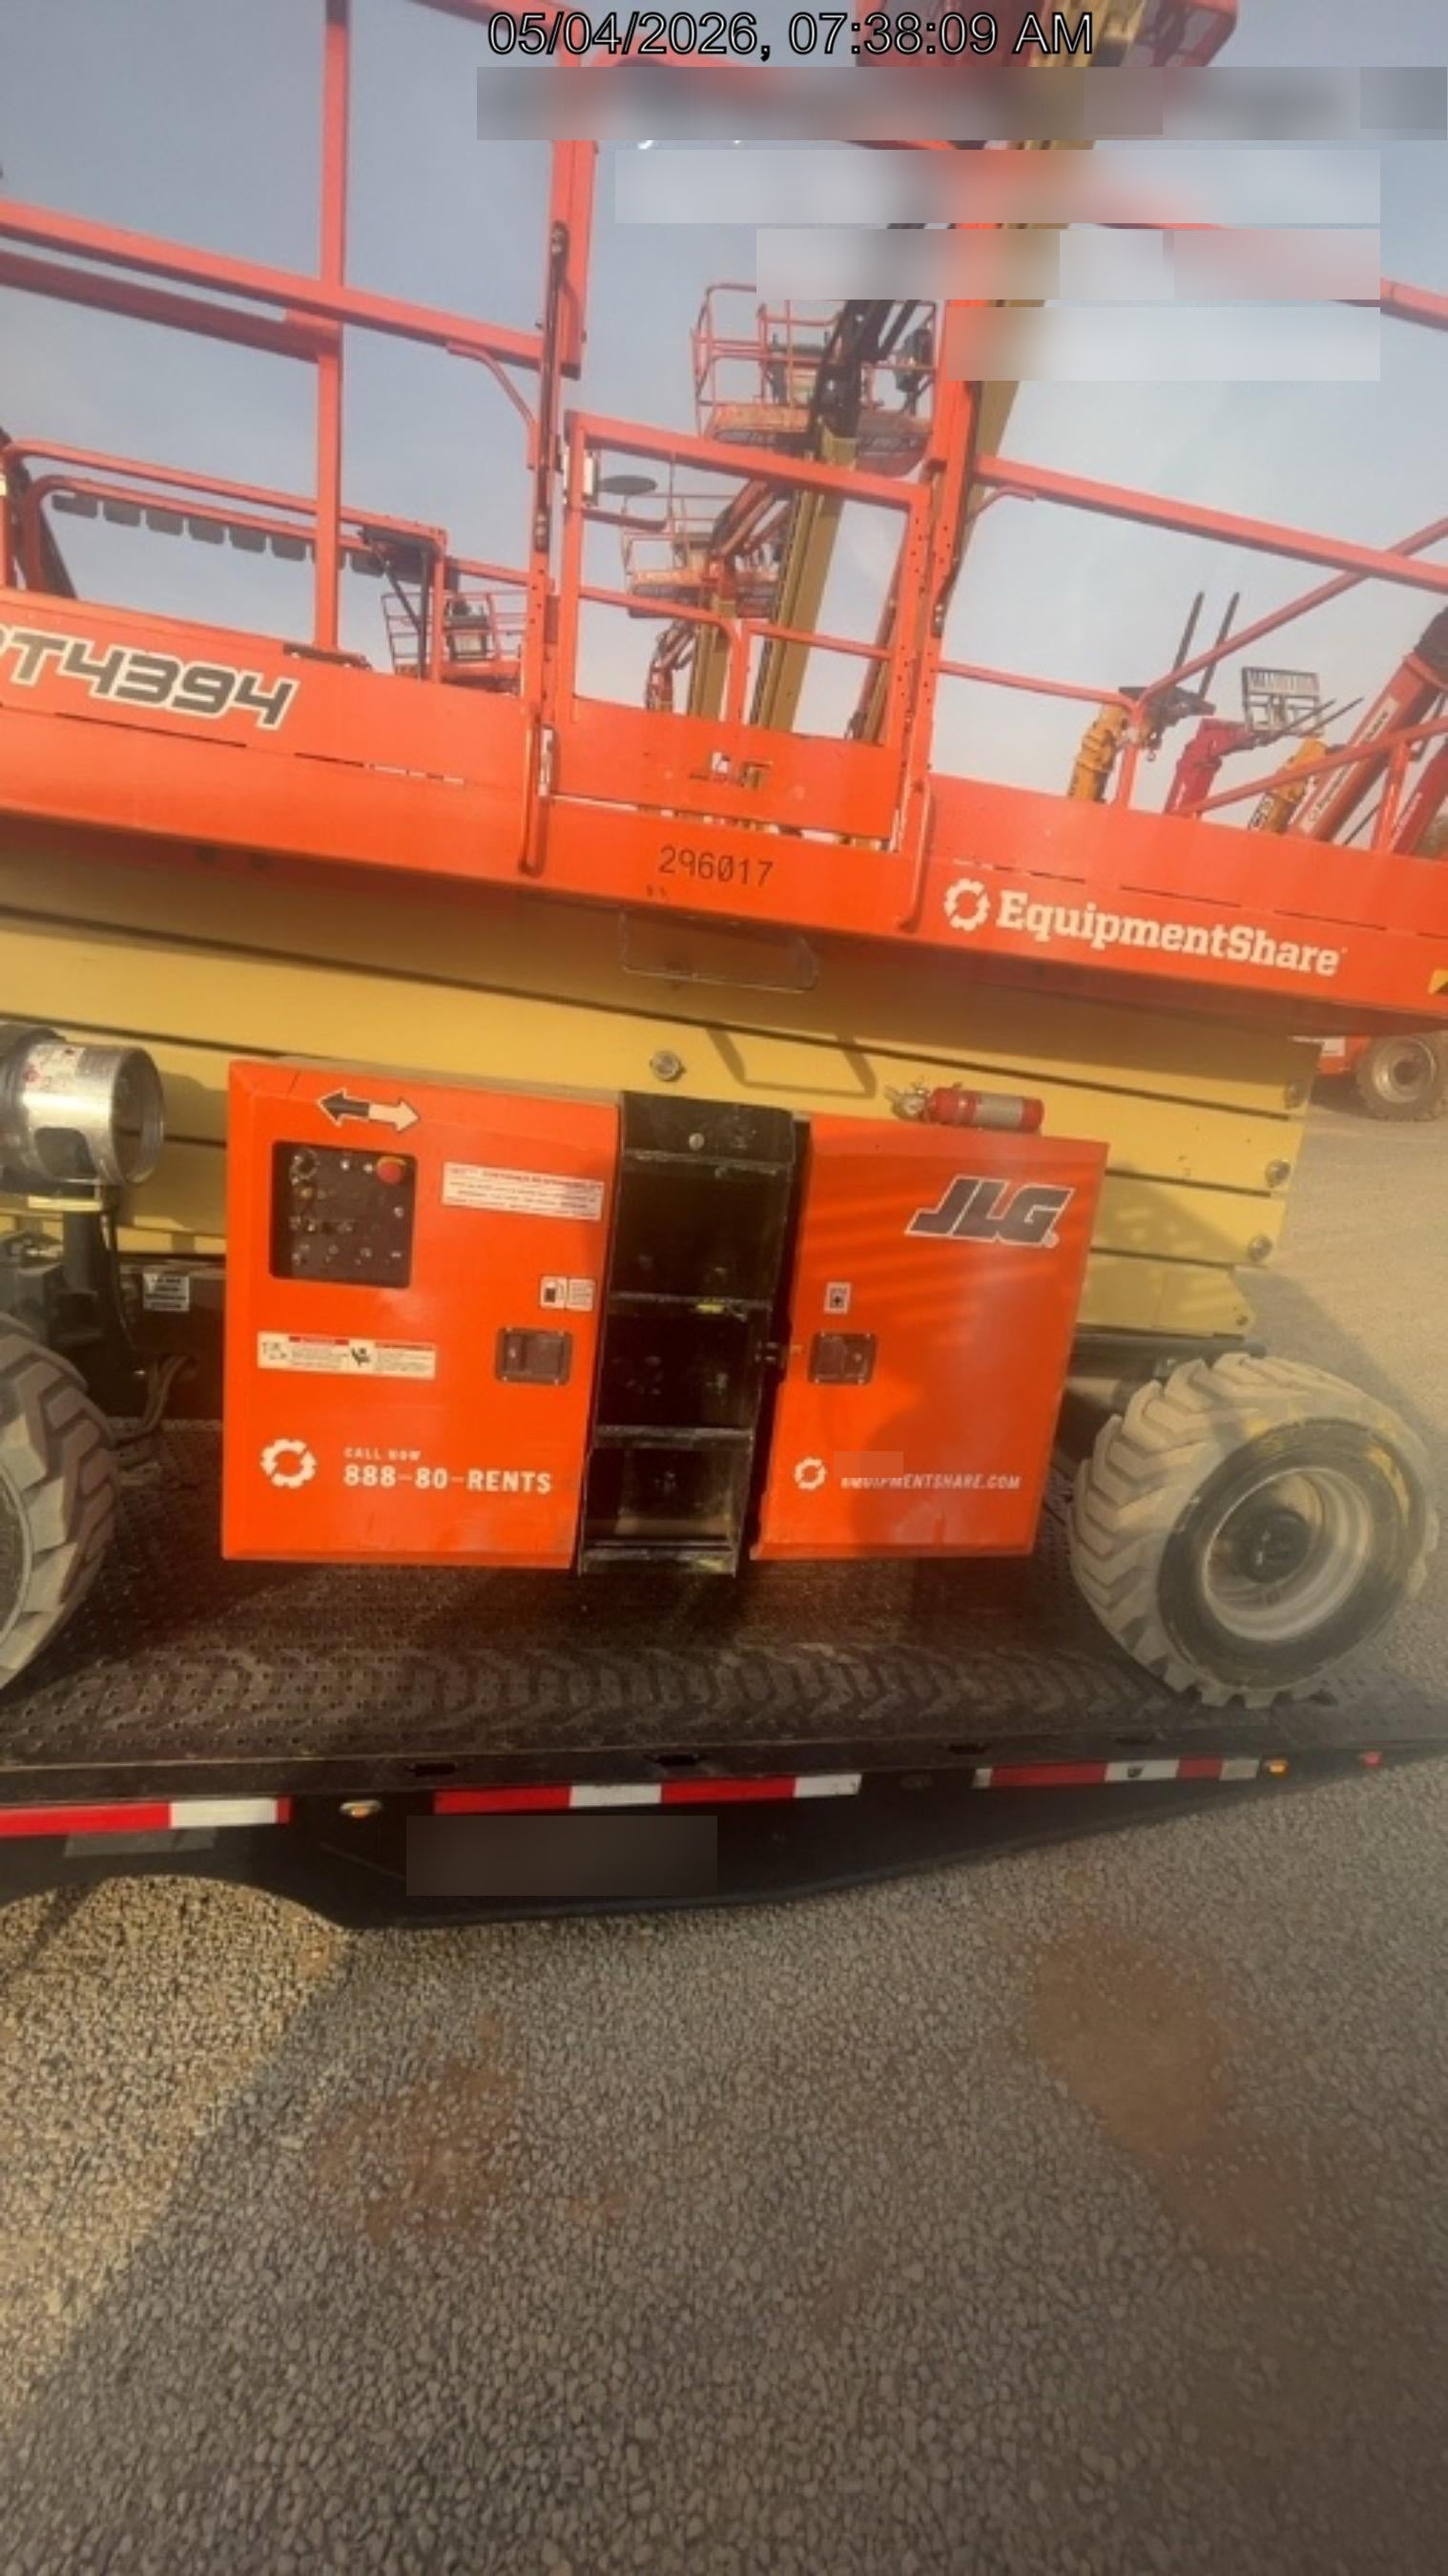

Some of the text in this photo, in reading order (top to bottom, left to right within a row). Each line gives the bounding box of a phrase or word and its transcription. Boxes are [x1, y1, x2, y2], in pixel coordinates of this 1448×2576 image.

[0, 625, 300, 731] T4394
[658, 844, 774, 888] 296017
[997, 889, 1341, 977] EquipmentShare
[904, 1174, 1076, 1247] JLG
[343, 1446, 383, 1461] CALL
[343, 1464, 552, 1495] 888-80-RENTS
